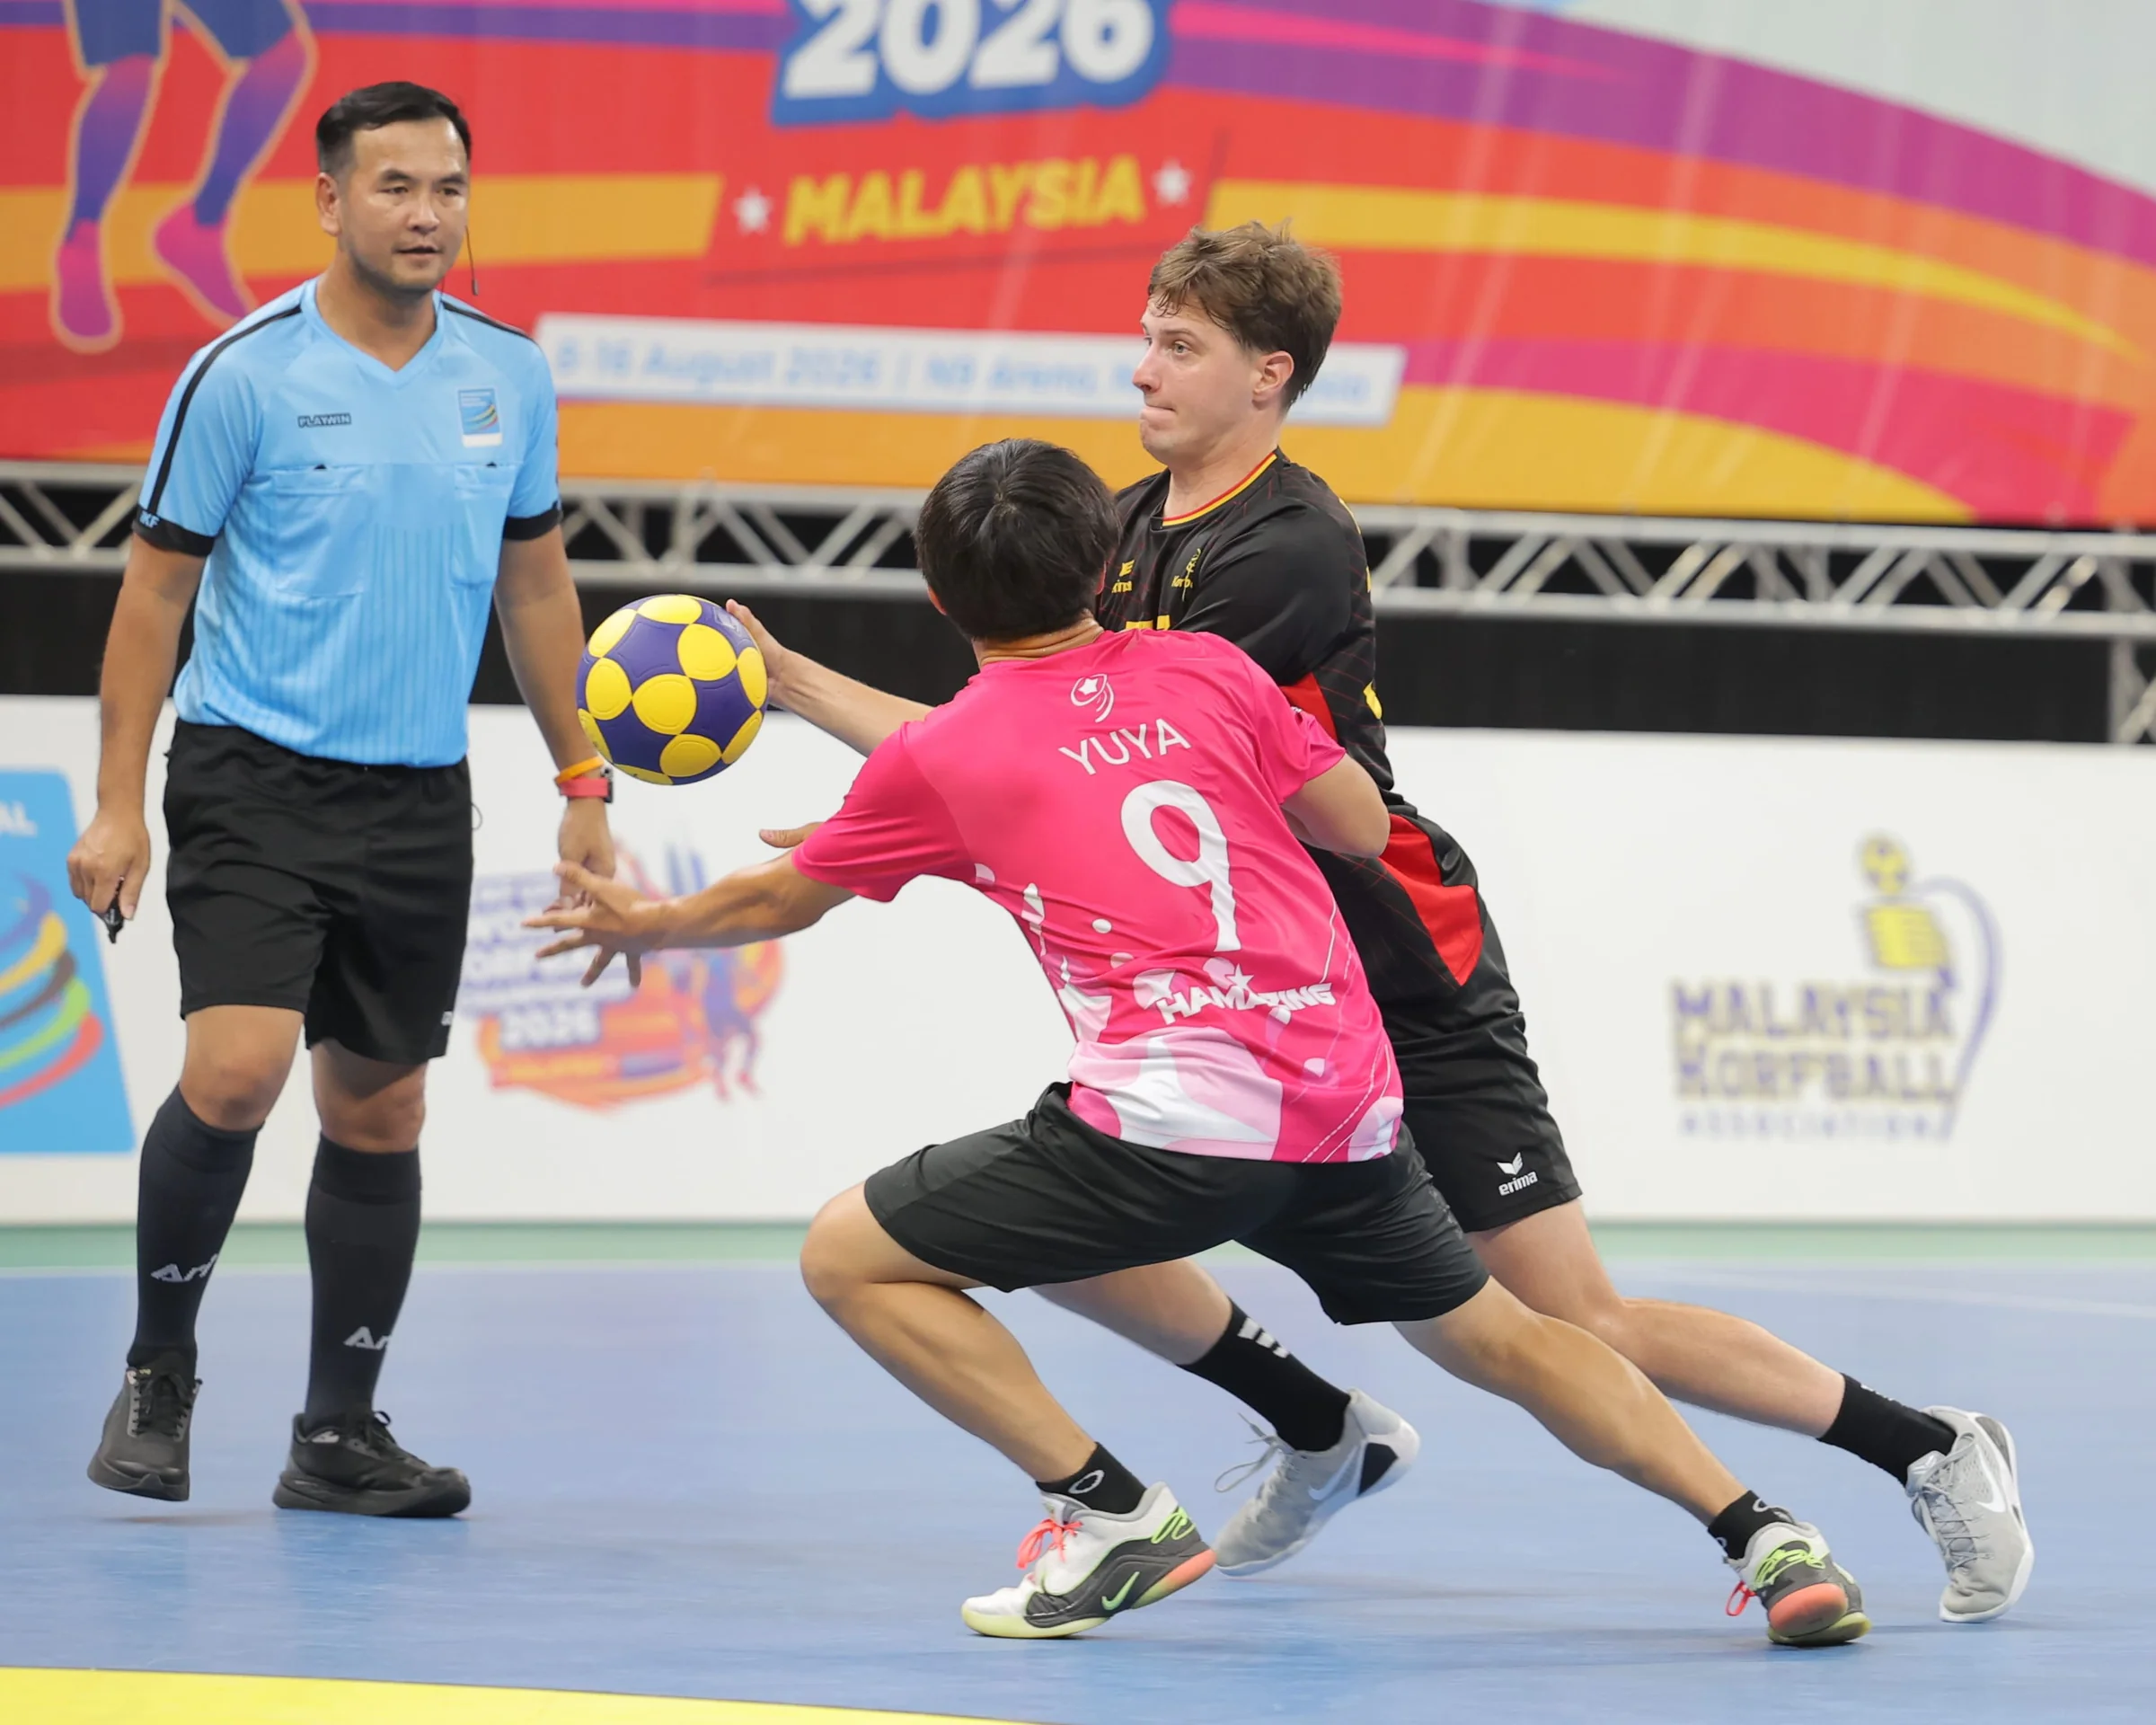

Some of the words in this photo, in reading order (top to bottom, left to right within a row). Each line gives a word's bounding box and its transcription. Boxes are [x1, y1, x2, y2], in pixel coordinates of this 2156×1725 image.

[781, 0, 1155, 100] 2026
[783, 153, 1147, 246] MALAYSIA
[297, 412, 352, 429] PLAYWIN
[1058, 718, 1192, 775] YUYA
[1120, 779, 1242, 952] 9
[1669, 979, 1957, 1039] MALAYSIA
[1498, 1170, 1539, 1197] erima
